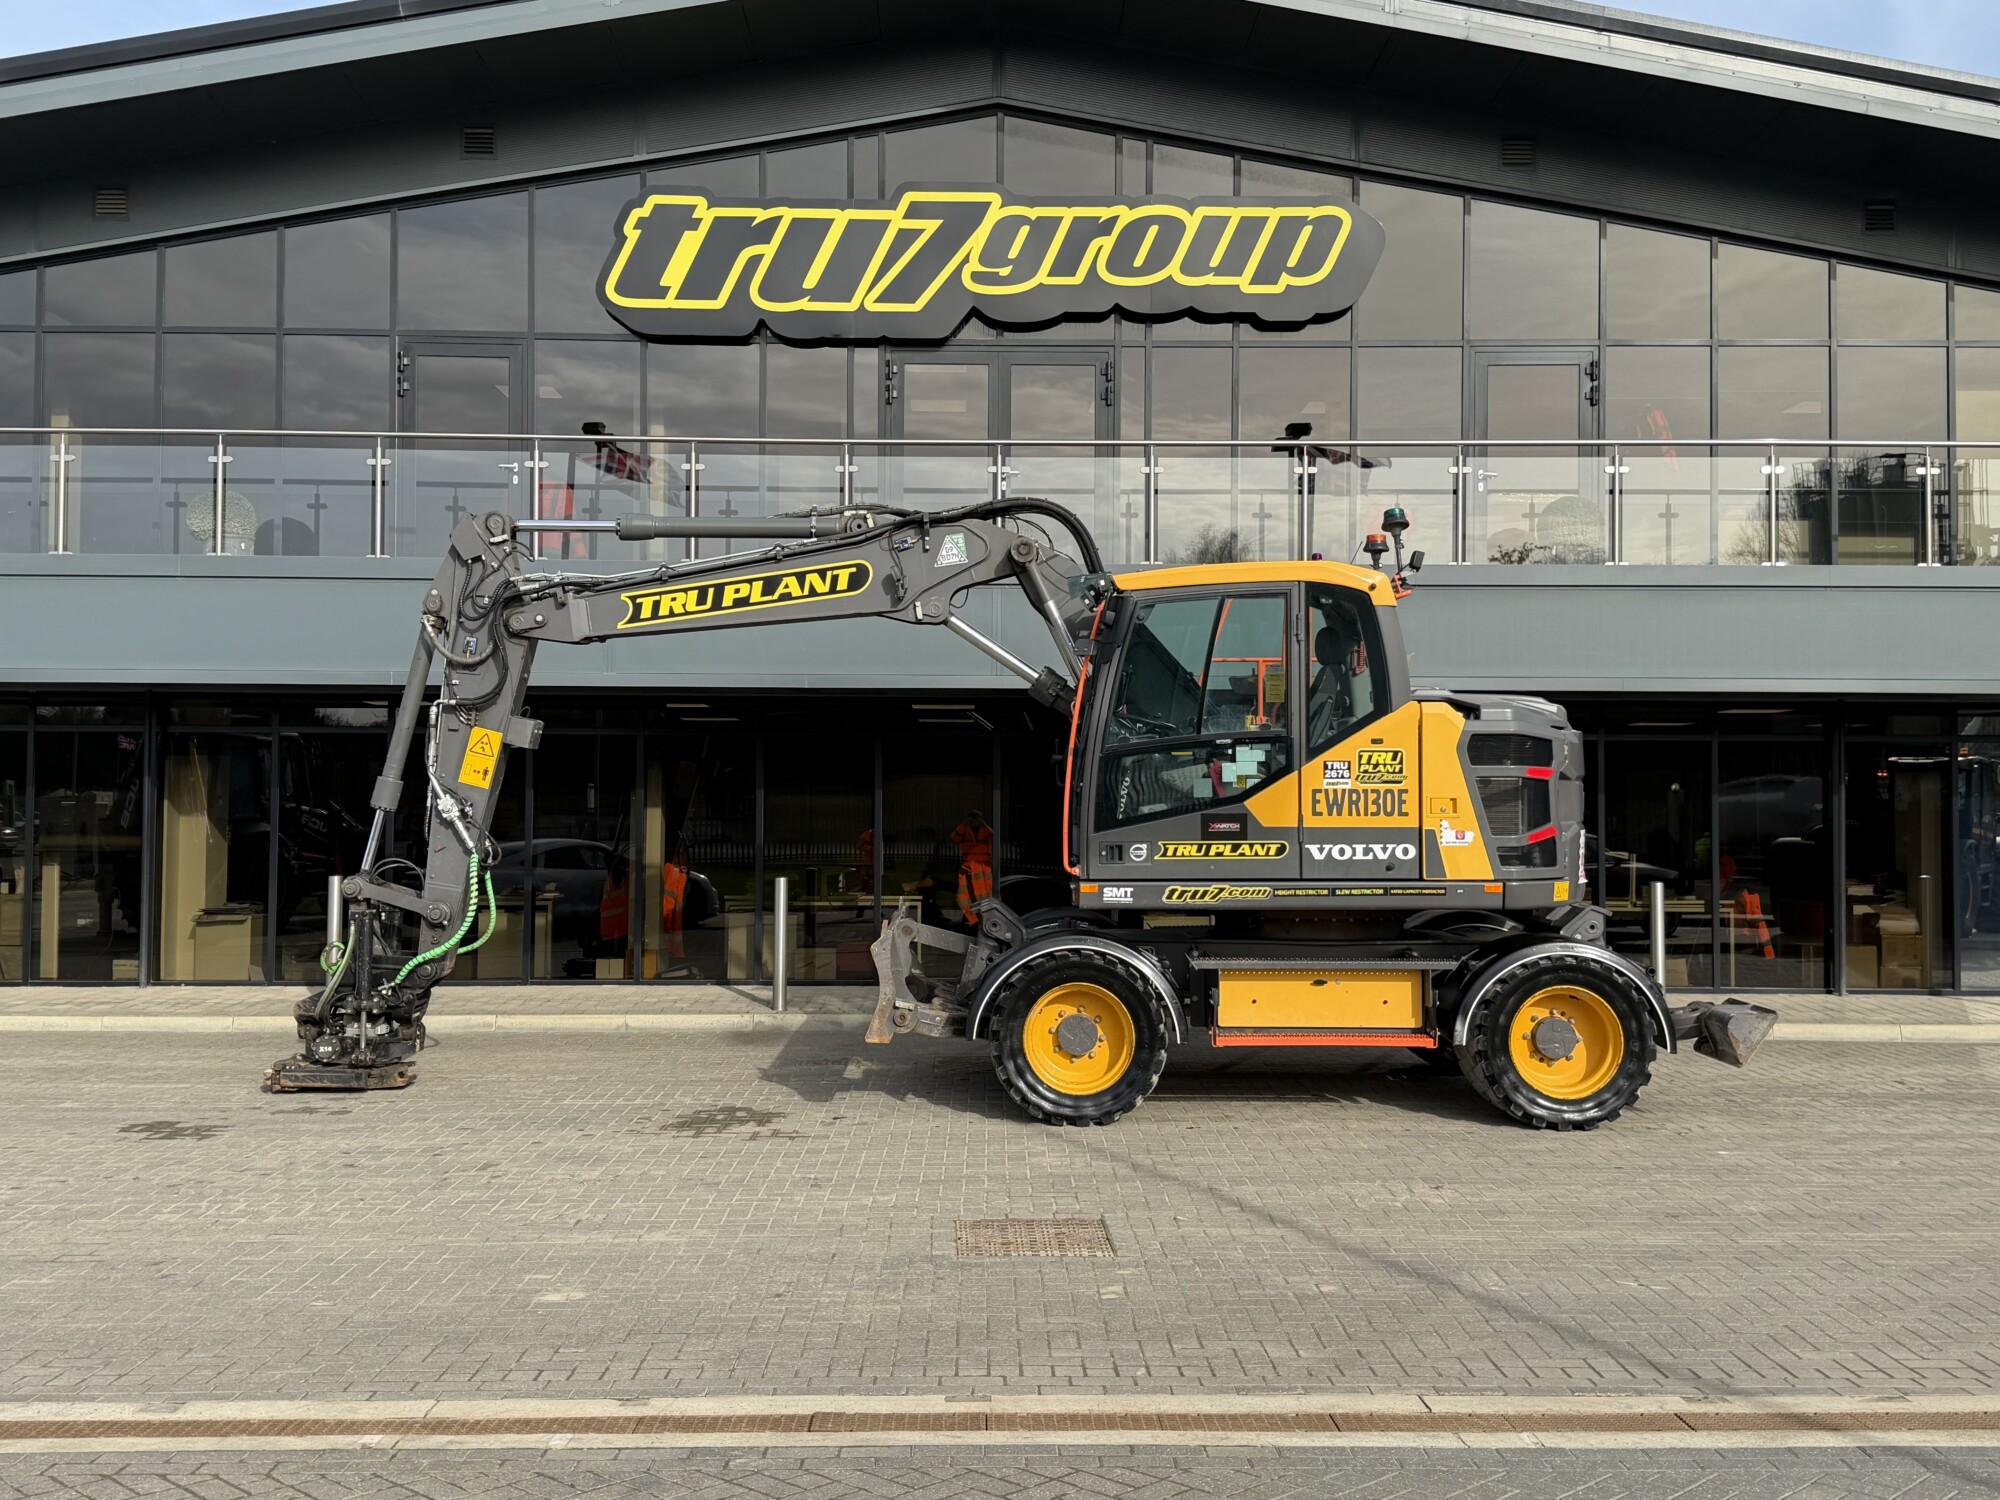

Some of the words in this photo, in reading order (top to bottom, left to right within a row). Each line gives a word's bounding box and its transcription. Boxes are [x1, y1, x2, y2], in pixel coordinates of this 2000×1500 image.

[605, 191, 1352, 312] tru7group
[635, 587, 715, 619] TRU
[721, 567, 857, 607] PLANT
[1359, 752, 1402, 764] TRU
[1325, 761, 1349, 769] TRU
[1359, 764, 1402, 772] PLANT
[1324, 770, 1350, 778] 2676
[1311, 788, 1409, 817] EWR130E
[1165, 844, 1207, 857] TRU
[1208, 844, 1281, 856] PLANT
[1304, 843, 1417, 860] VOLVO
[1103, 887, 1133, 898] SMT
[1162, 884, 1273, 904] tru7.com
